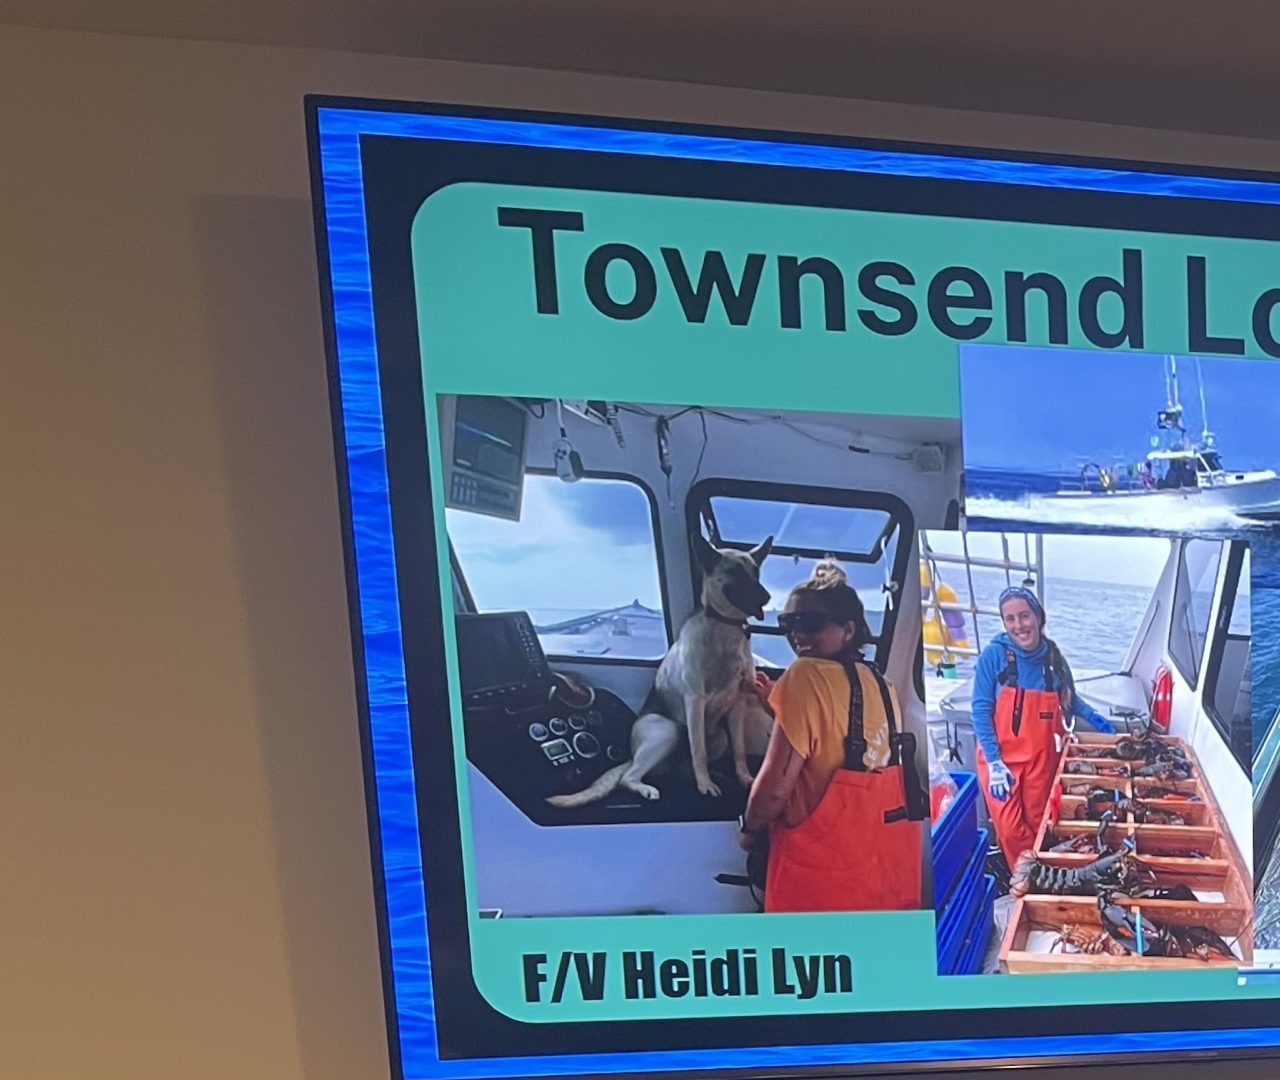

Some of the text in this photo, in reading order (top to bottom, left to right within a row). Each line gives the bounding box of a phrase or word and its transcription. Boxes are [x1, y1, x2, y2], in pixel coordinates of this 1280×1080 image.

[497, 206, 1145, 350] Townsend
[522, 947, 853, 1004] F/V Heidi Lyn
